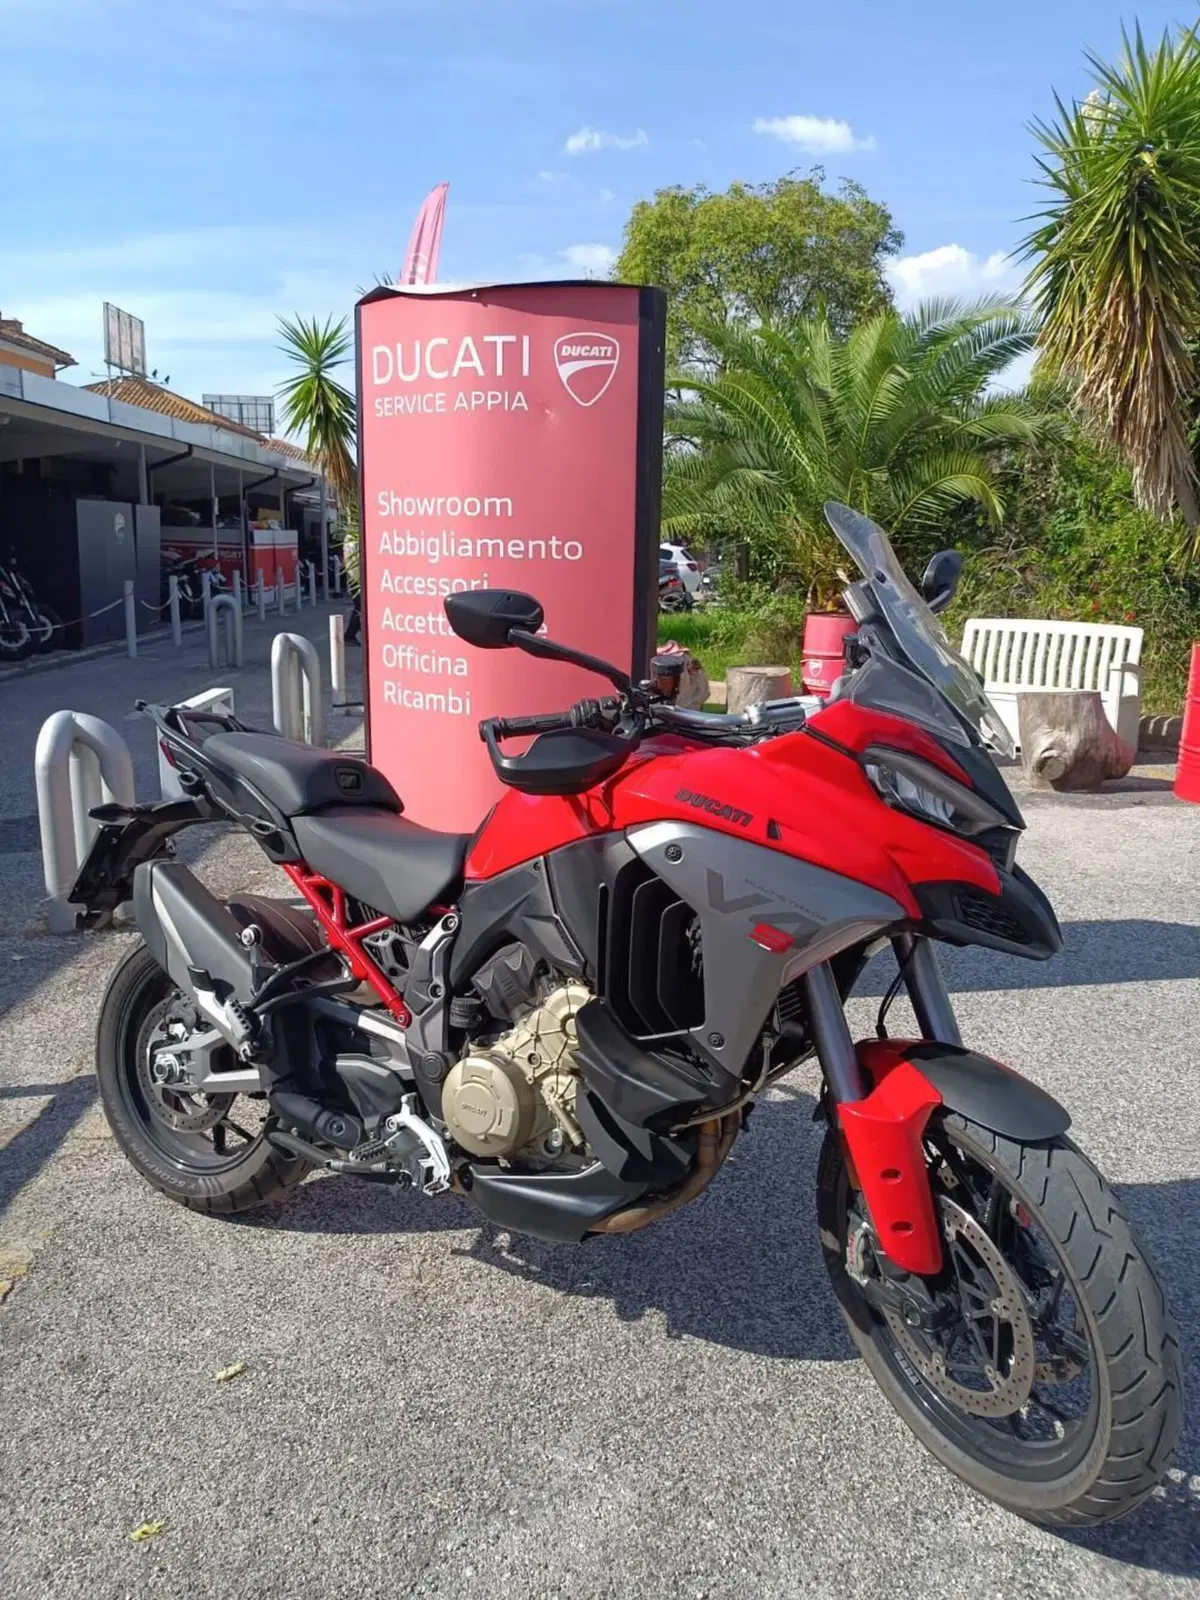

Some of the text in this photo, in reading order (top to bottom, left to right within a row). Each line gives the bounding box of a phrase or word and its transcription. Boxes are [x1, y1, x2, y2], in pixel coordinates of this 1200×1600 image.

[372, 335, 530, 385] DUCATI
[561, 345, 613, 357] DUCATI
[374, 391, 529, 418] SERVICE APPIA
[377, 490, 513, 517] Showroom
[378, 529, 583, 564] Abbigliamento
[380, 568, 489, 596] Accessori
[382, 643, 468, 677] Officina
[383, 680, 471, 715] Ricambi
[675, 789, 754, 827] DUCATI
